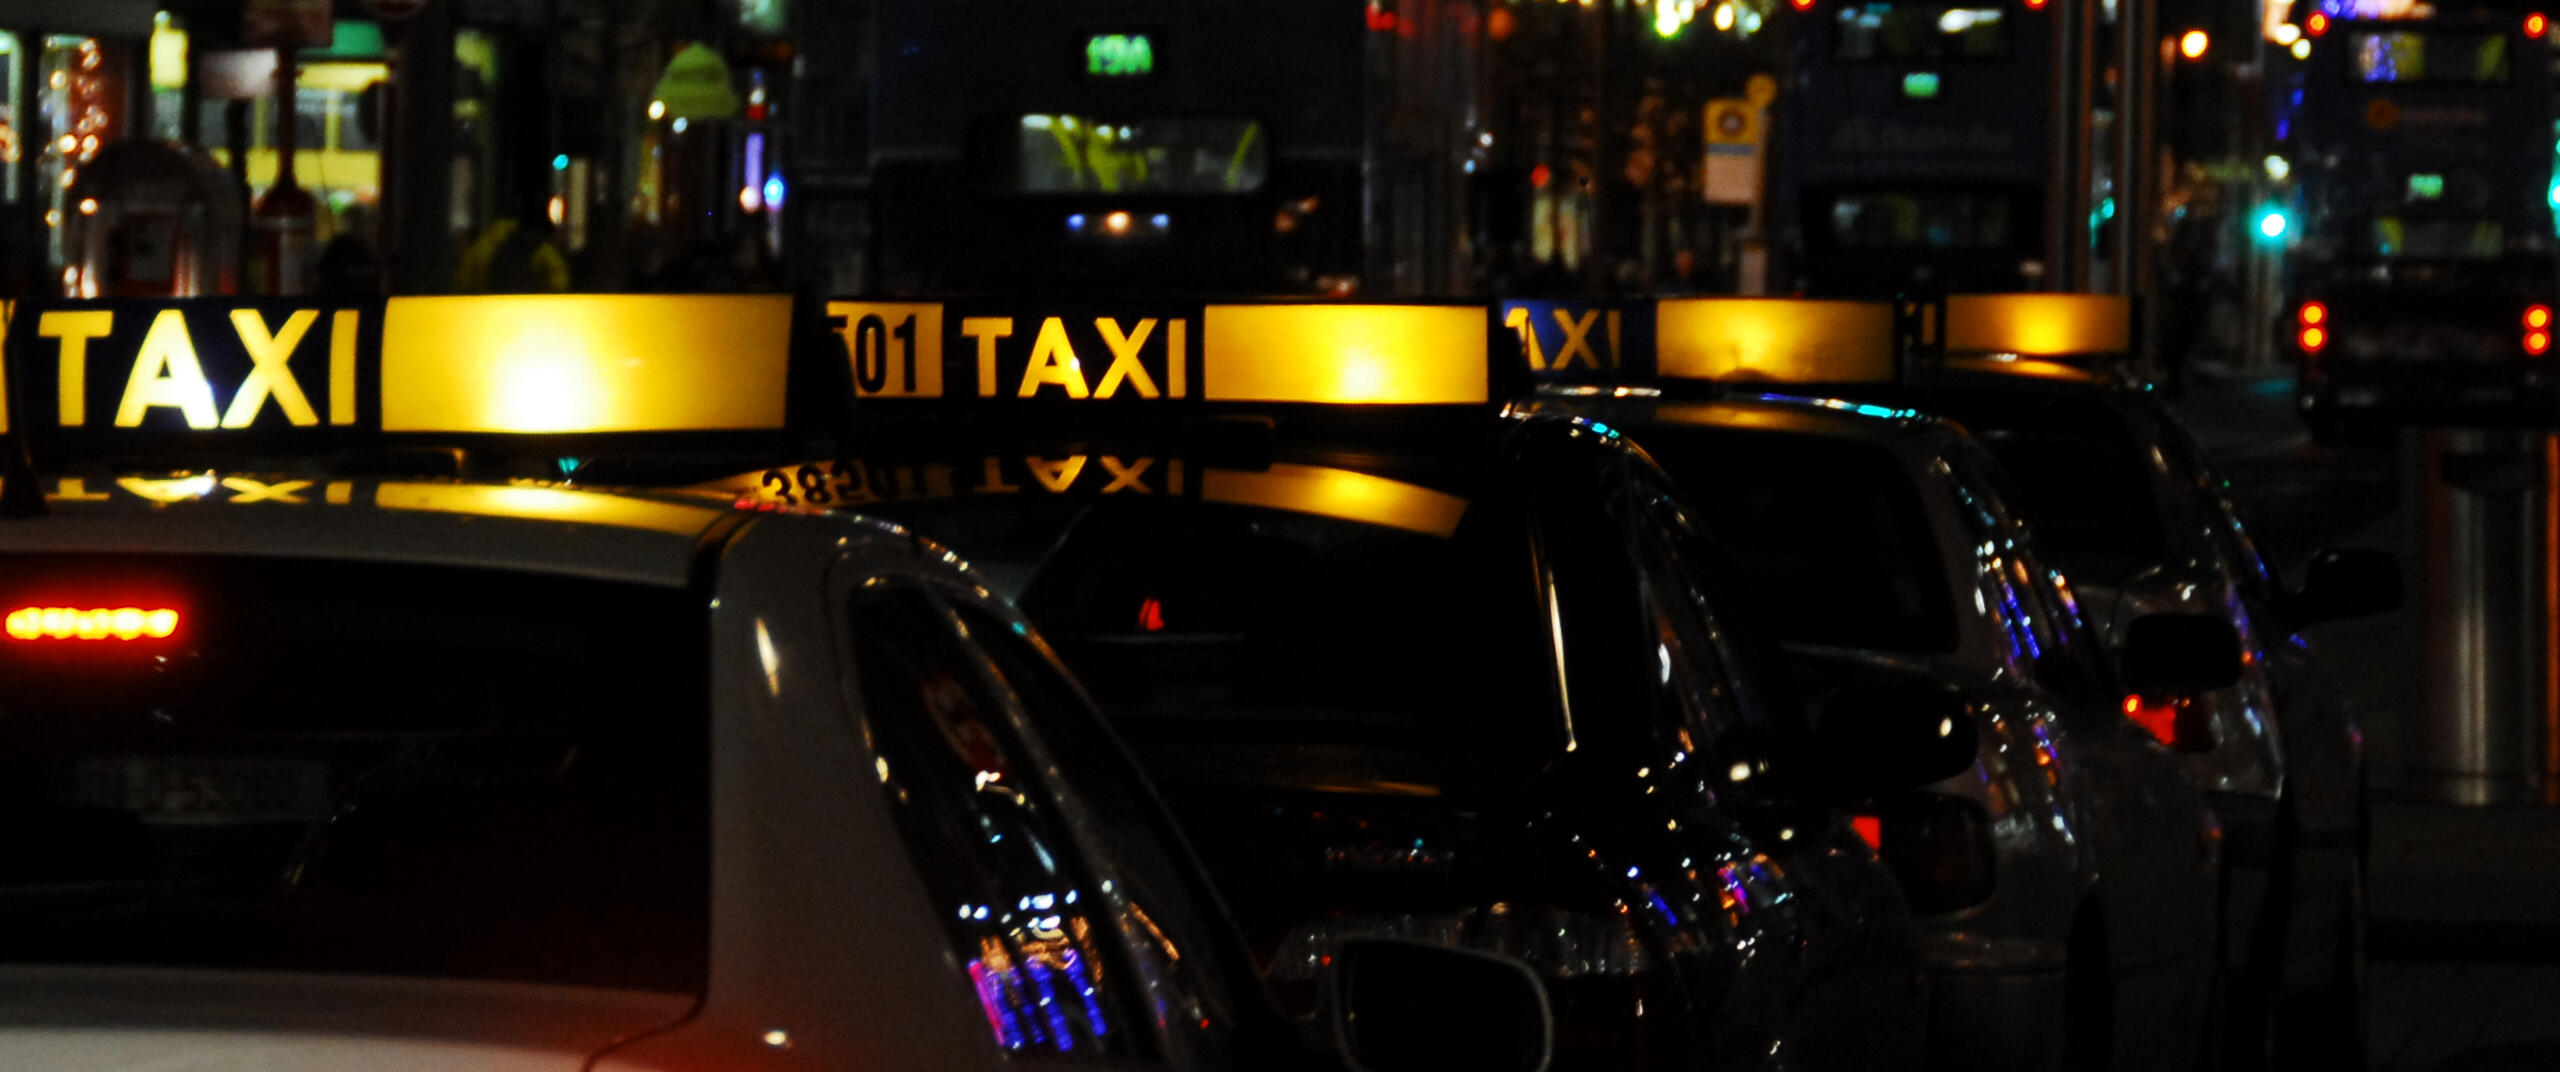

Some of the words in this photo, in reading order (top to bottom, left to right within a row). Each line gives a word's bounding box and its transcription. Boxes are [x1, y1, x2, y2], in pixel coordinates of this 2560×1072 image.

[38, 309, 359, 429] TAXI
[831, 314, 917, 393] 01
[961, 316, 1186, 399] TAXI
[1504, 306, 1620, 371] AXI
